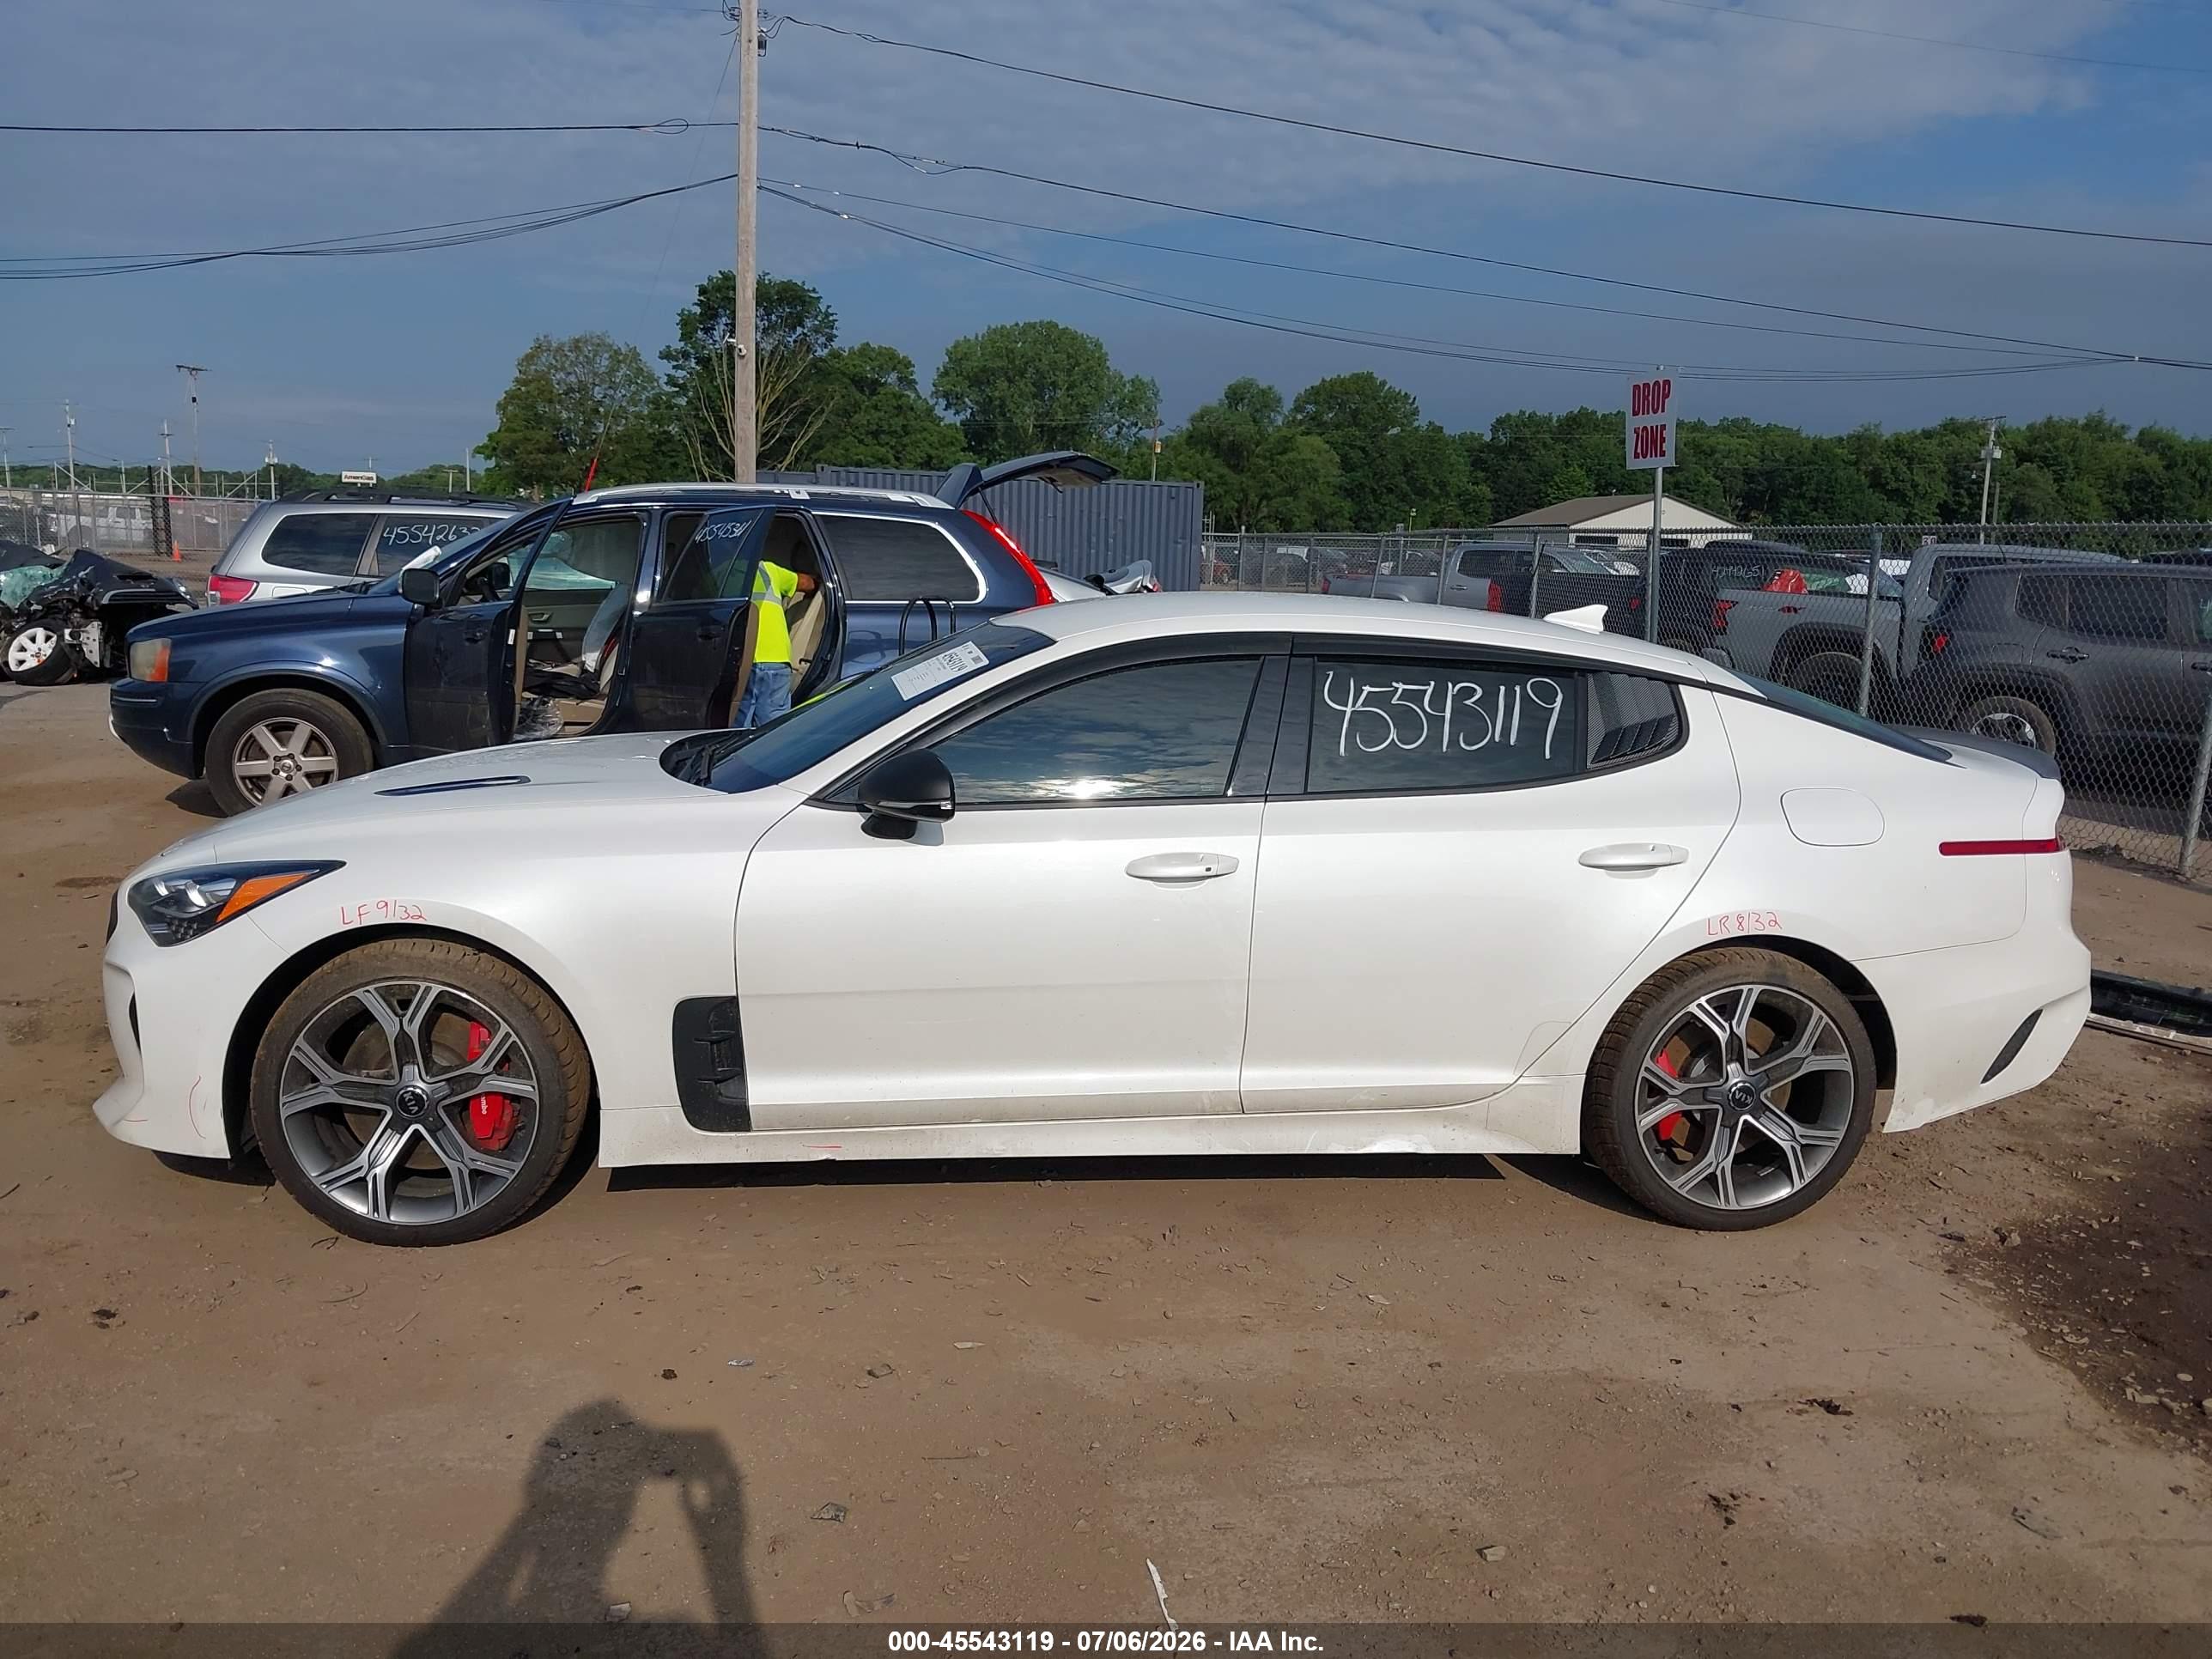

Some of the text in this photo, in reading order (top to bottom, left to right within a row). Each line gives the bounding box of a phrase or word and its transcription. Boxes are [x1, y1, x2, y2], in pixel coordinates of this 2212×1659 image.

[1632, 380, 1672, 416] DROP
[1633, 424, 1667, 459] ZONE
[384, 525, 480, 545] 4554263
[1323, 671, 1564, 759] 45543119
[341, 904, 371, 926] LF
[1707, 915, 1730, 935] LR
[403, 1091, 419, 1114] KIA
[1735, 1090, 1753, 1104] KIA
